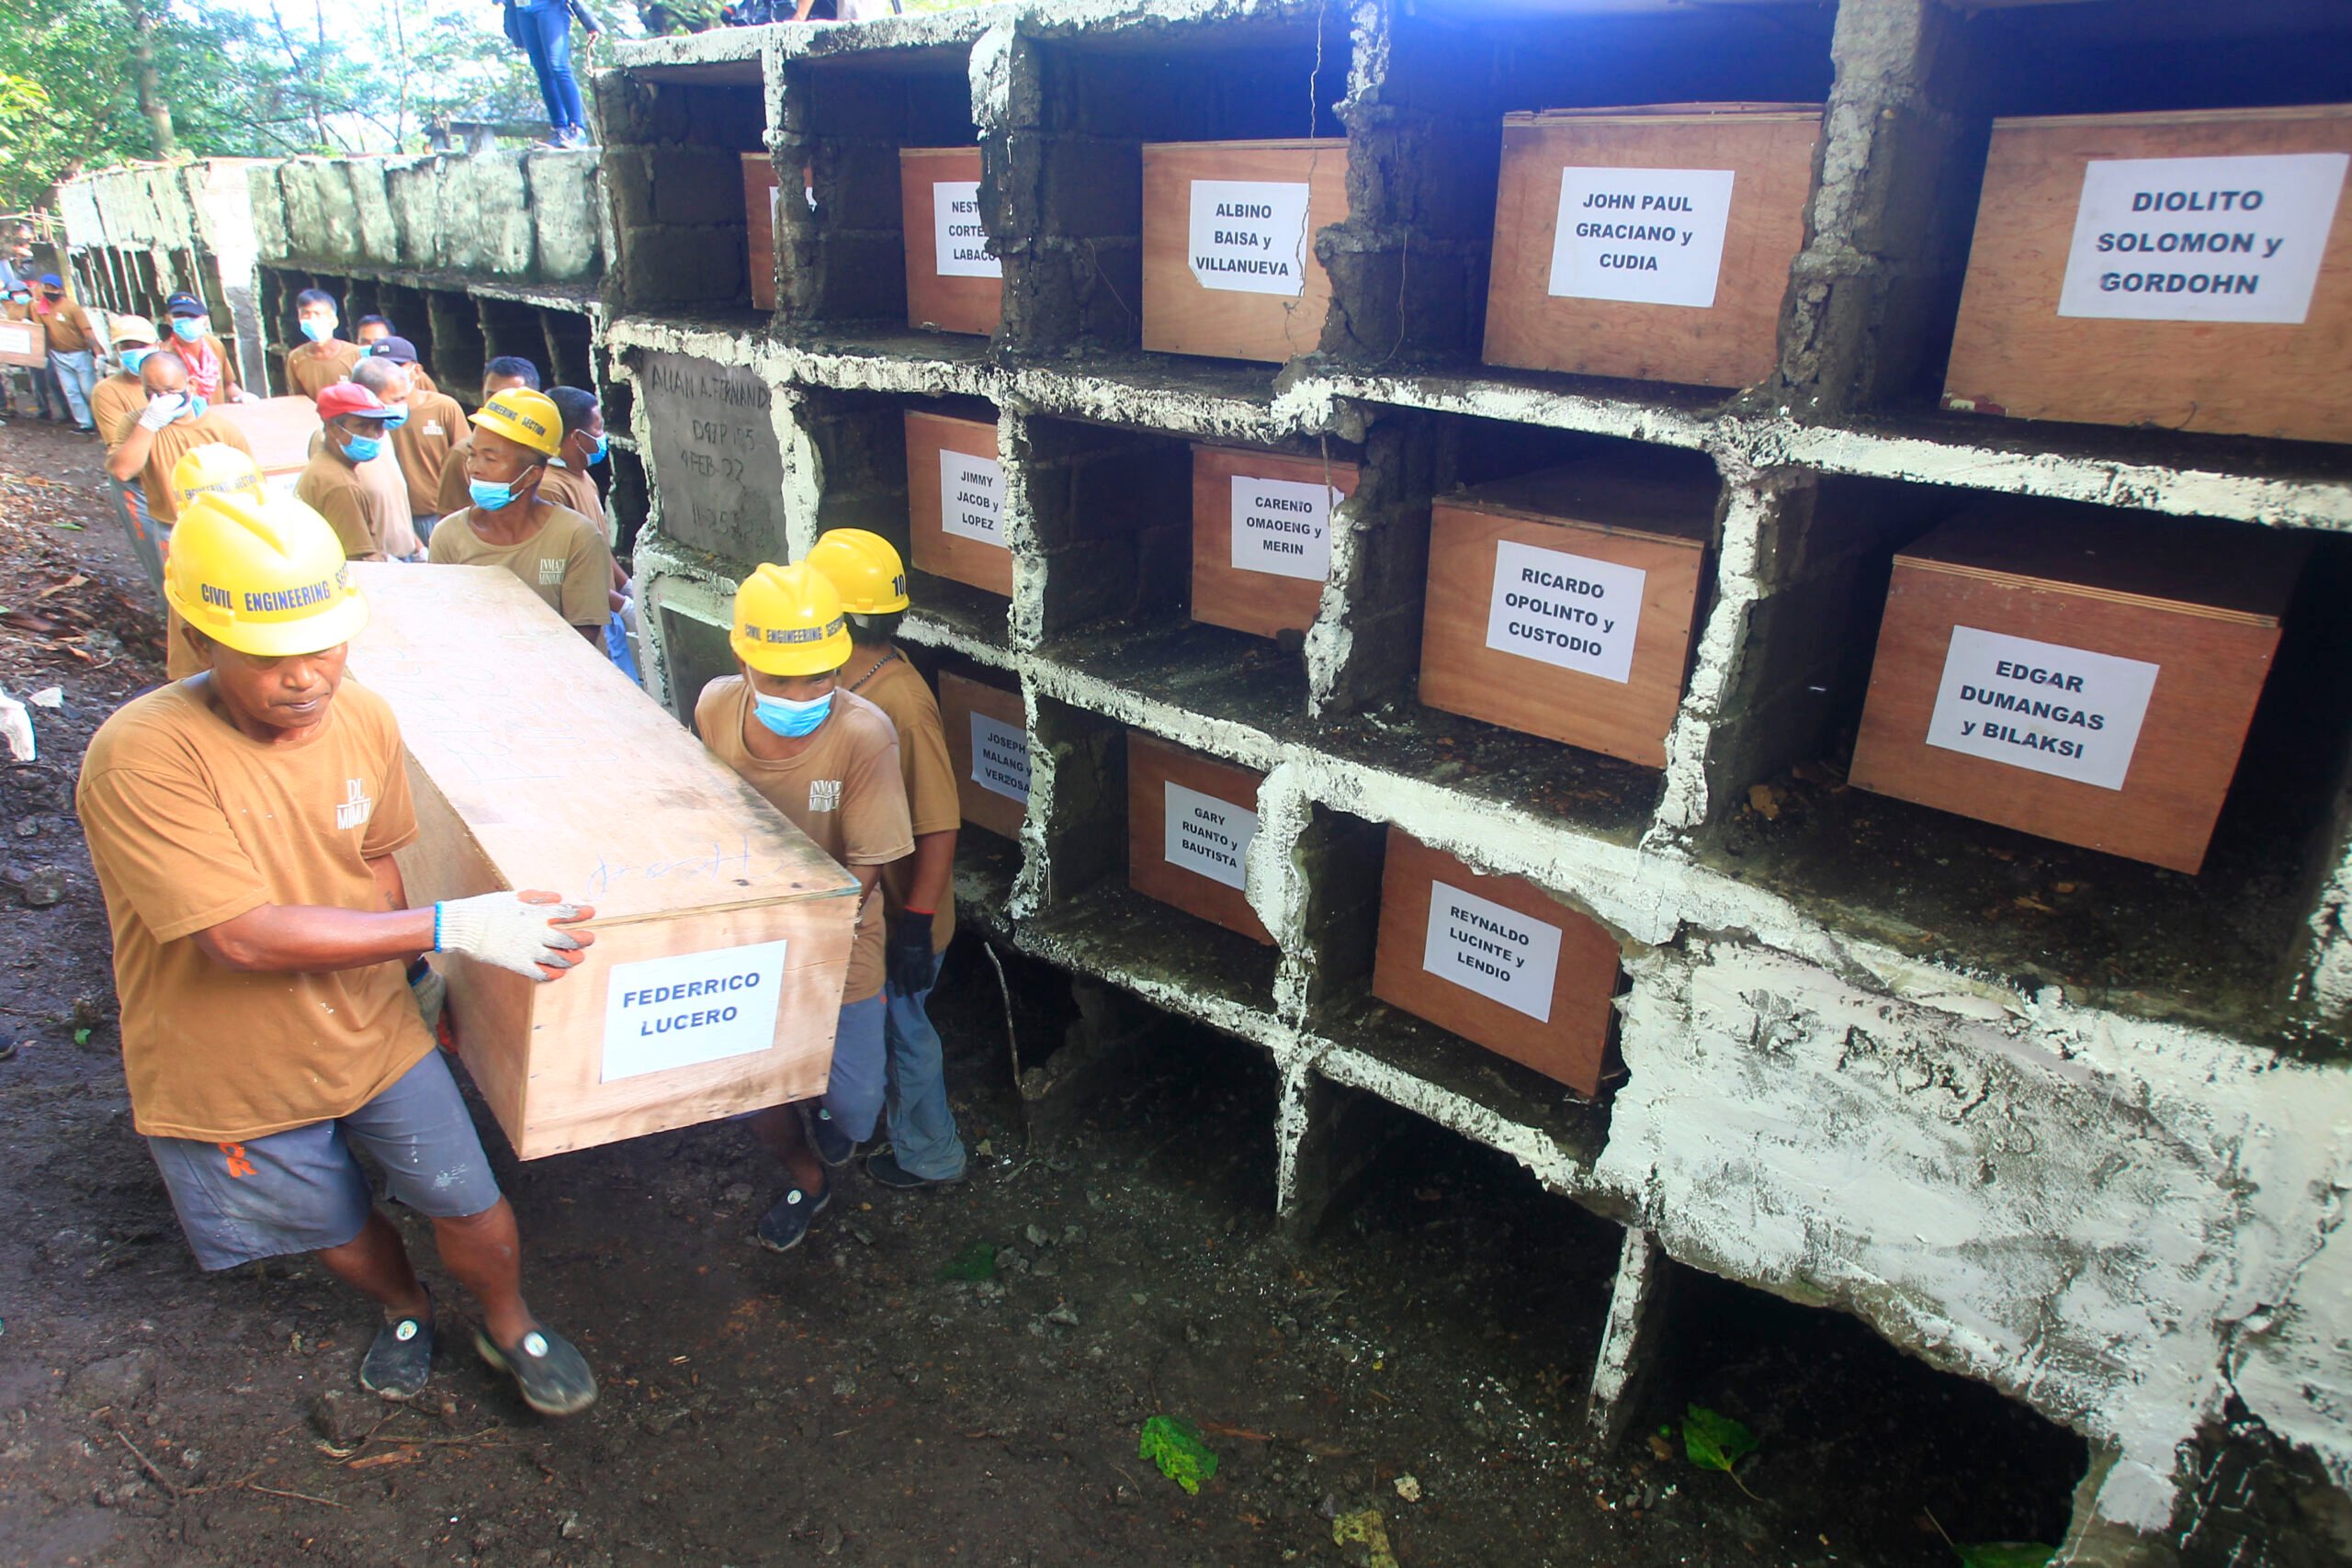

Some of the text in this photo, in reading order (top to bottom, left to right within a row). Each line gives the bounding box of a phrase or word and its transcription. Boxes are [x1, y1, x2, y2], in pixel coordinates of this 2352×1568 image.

[1216, 203, 1272, 219] ALBINO
[1583, 193, 1692, 212] JOHN PAUL
[2132, 190, 2264, 212] DIOLITO
[948, 225, 989, 237] CORTE
[1215, 231, 1272, 250] BAISA y
[1576, 222, 1692, 246] GRACIANO y
[2096, 232, 2284, 258] SOLOMON y
[1195, 256, 1289, 276] VILLANUEVA
[1599, 254, 1658, 271] CUDIA
[2099, 272, 2259, 295] GORDOHN
[961, 470, 993, 488] JIMMY
[956, 491, 999, 513] JACOB y
[962, 513, 994, 530] LOPEZ
[1246, 516, 1322, 538] OMAOENG y
[1262, 539, 1304, 555] MERIN
[1521, 567, 1604, 599] RICARDO
[201, 582, 233, 609] CIVIL
[244, 580, 331, 612] ENGINEERING
[1505, 592, 1615, 634] OPOLINTO y
[745, 623, 762, 641] CIVIL
[766, 626, 823, 644] ENGINEERING
[1509, 621, 1602, 656] CUSTODIO
[1996, 660, 2085, 694] EDGAR
[1960, 684, 2105, 730] DUMANGAS
[988, 733, 1026, 754] JOSEPH
[1961, 720, 2085, 760] y BILAKSI
[982, 749, 1032, 777] MALANG y
[985, 767, 1030, 793] VERZOSA
[1194, 807, 1226, 826] GARY
[1182, 820, 1238, 852] RUANTO y
[1182, 839, 1238, 868] BAUTISTA
[1450, 905, 1530, 946] REYNALDO
[1449, 927, 1525, 968] LUCINTE y
[1457, 952, 1510, 982] LENDIO
[622, 971, 761, 1009] FEDERRICO
[640, 1006, 738, 1037] LUCERO
